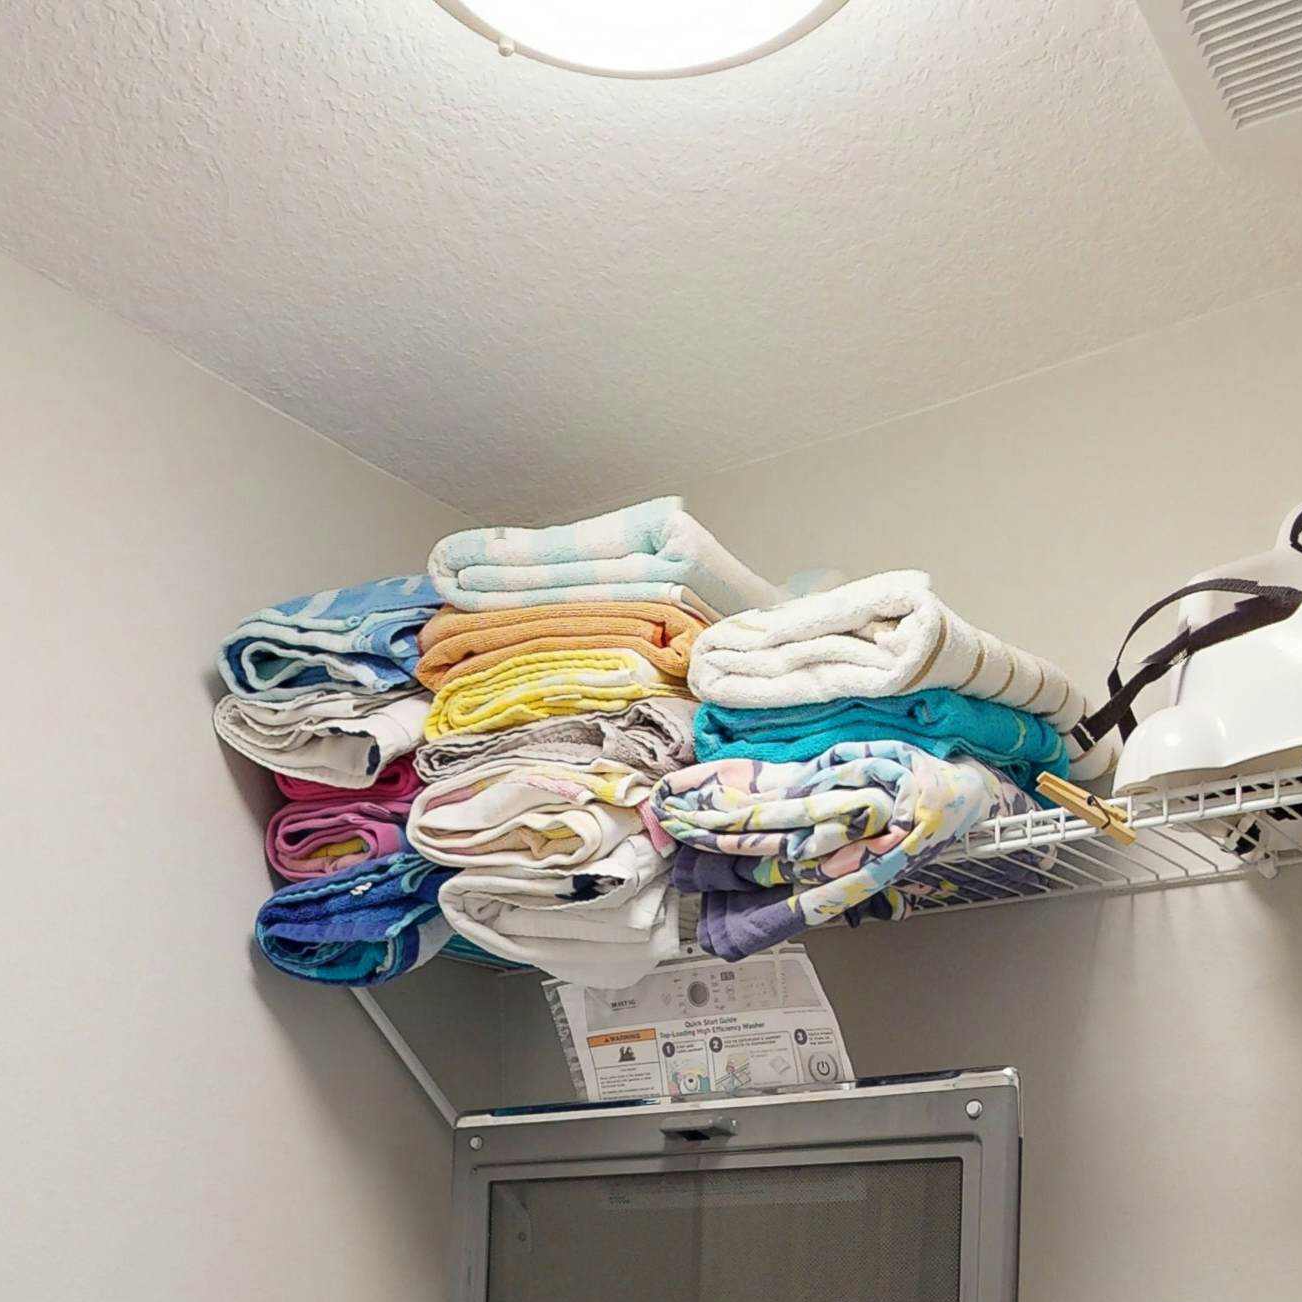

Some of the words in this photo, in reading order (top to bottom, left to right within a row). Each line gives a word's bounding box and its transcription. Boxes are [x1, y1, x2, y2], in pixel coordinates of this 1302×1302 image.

[684, 1020, 702, 1028] Quick
[703, 1018, 718, 1026] Start
[719, 1016, 737, 1024] Guide
